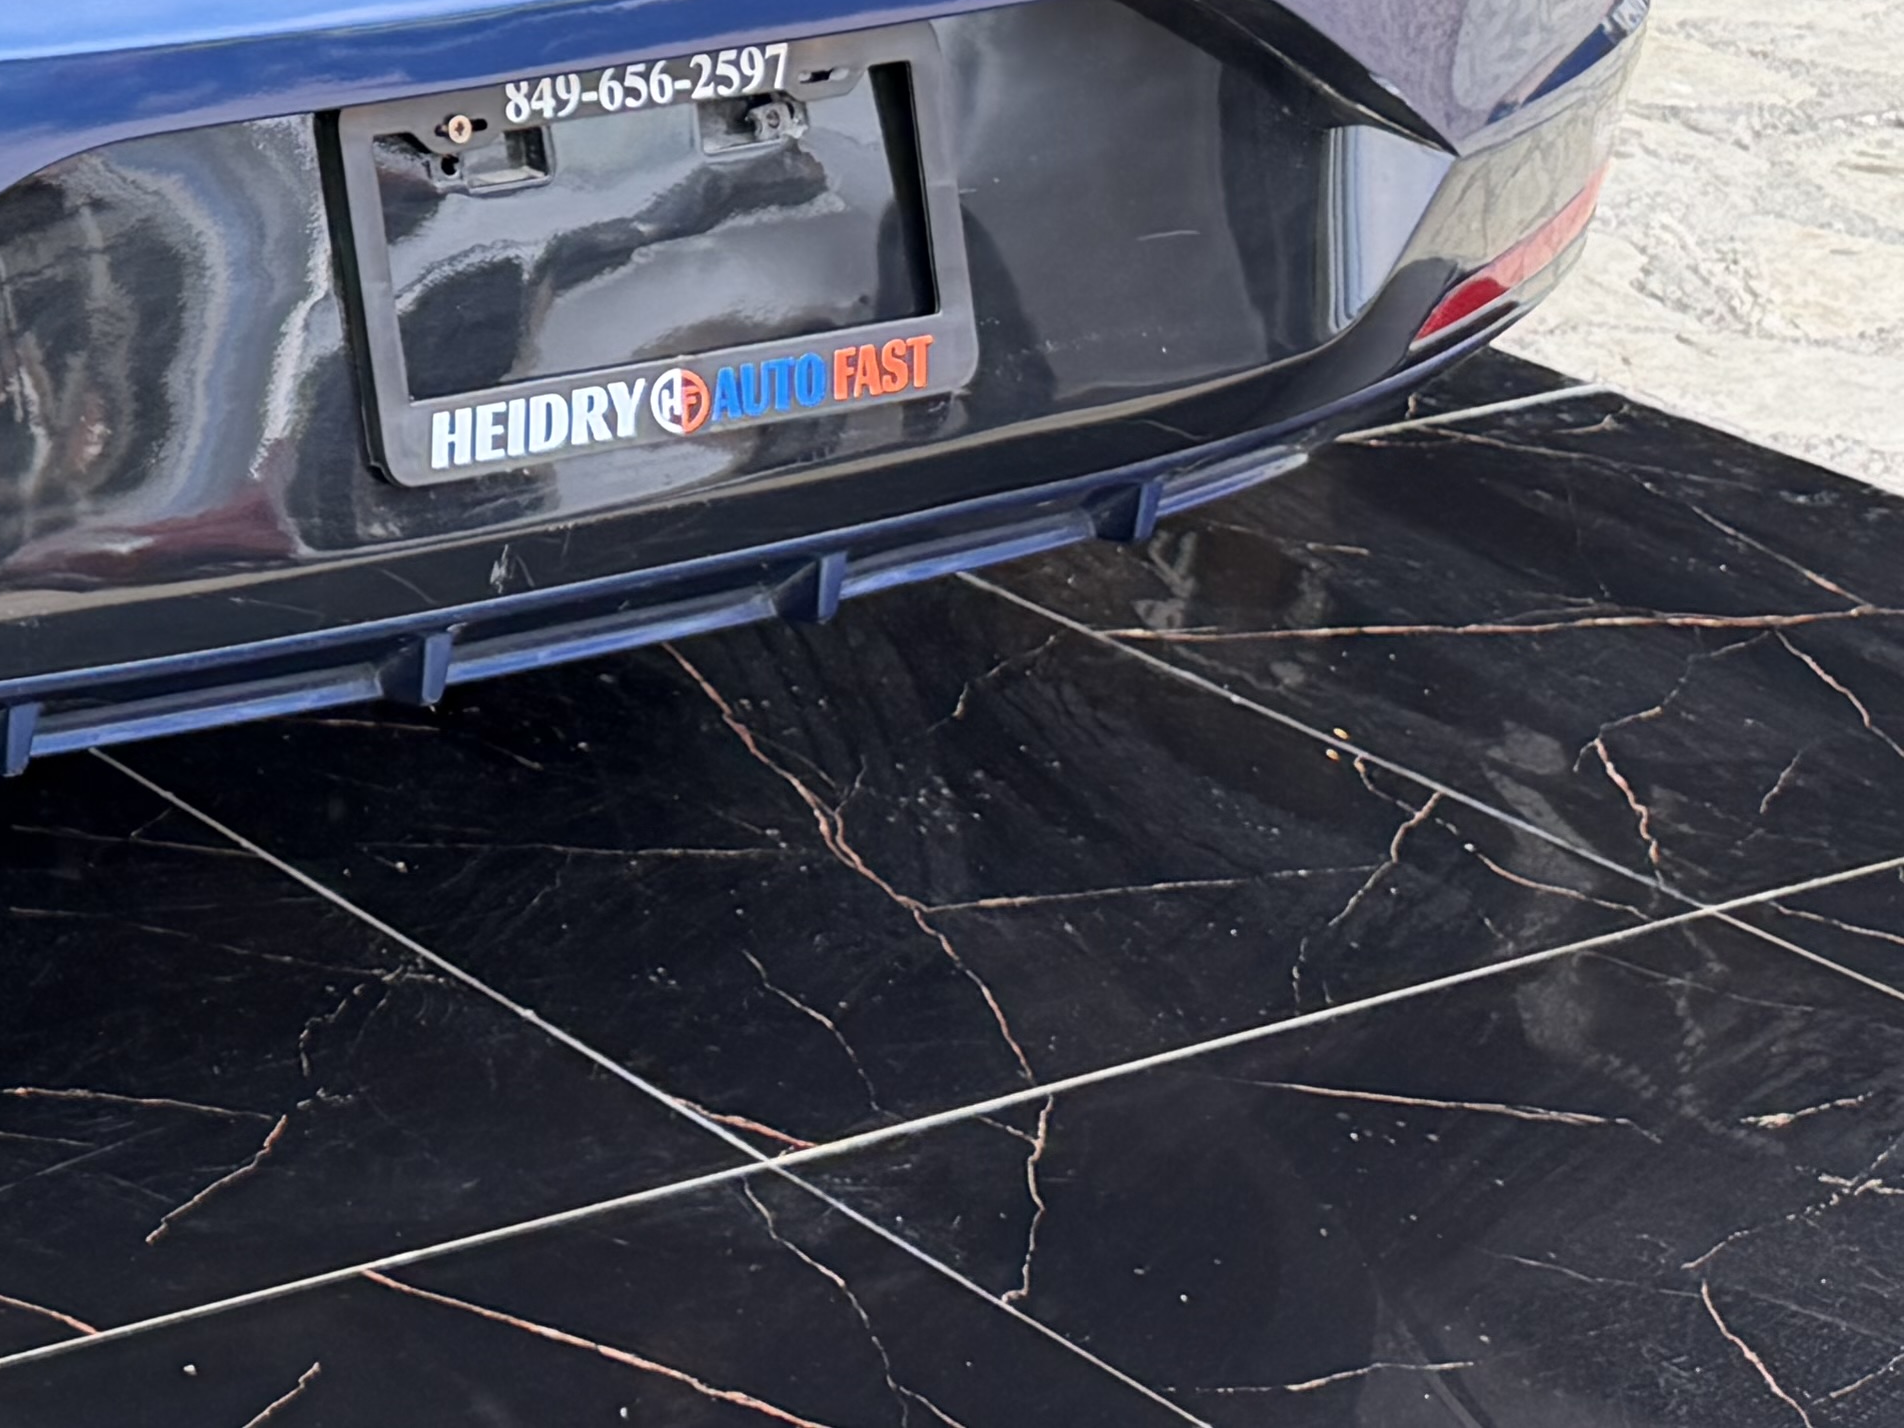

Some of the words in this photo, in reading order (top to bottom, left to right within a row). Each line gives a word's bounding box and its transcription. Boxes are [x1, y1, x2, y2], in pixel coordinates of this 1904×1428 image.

[505, 42, 789, 124] 849-656-2597
[430, 378, 647, 470] HEIDRY
[711, 353, 827, 422] AUTO
[833, 334, 934, 401] FAST
